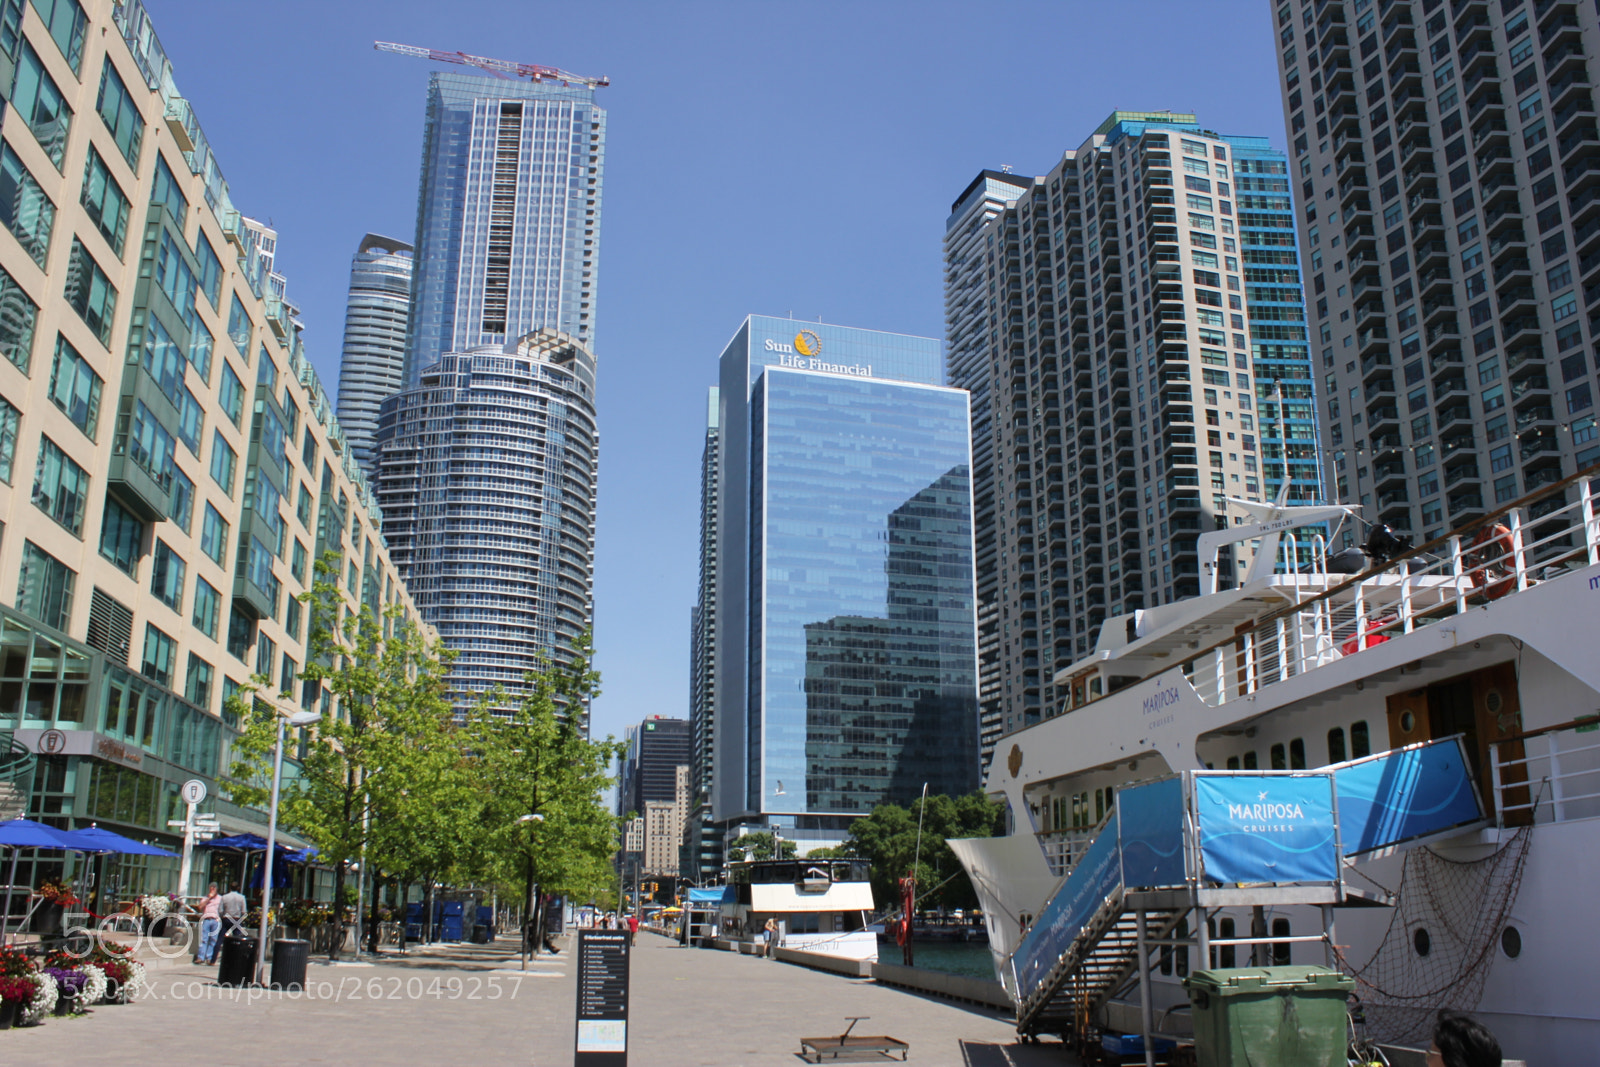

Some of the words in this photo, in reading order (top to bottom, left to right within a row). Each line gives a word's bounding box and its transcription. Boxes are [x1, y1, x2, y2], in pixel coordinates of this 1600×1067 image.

[765, 339, 792, 353] Sun
[779, 354, 806, 369] Life
[809, 357, 872, 377] Financial
[1143, 687, 1180, 715] MARIPOSA
[1228, 803, 1304, 822] MARIPOSA
[1243, 824, 1294, 832] CRUISES
